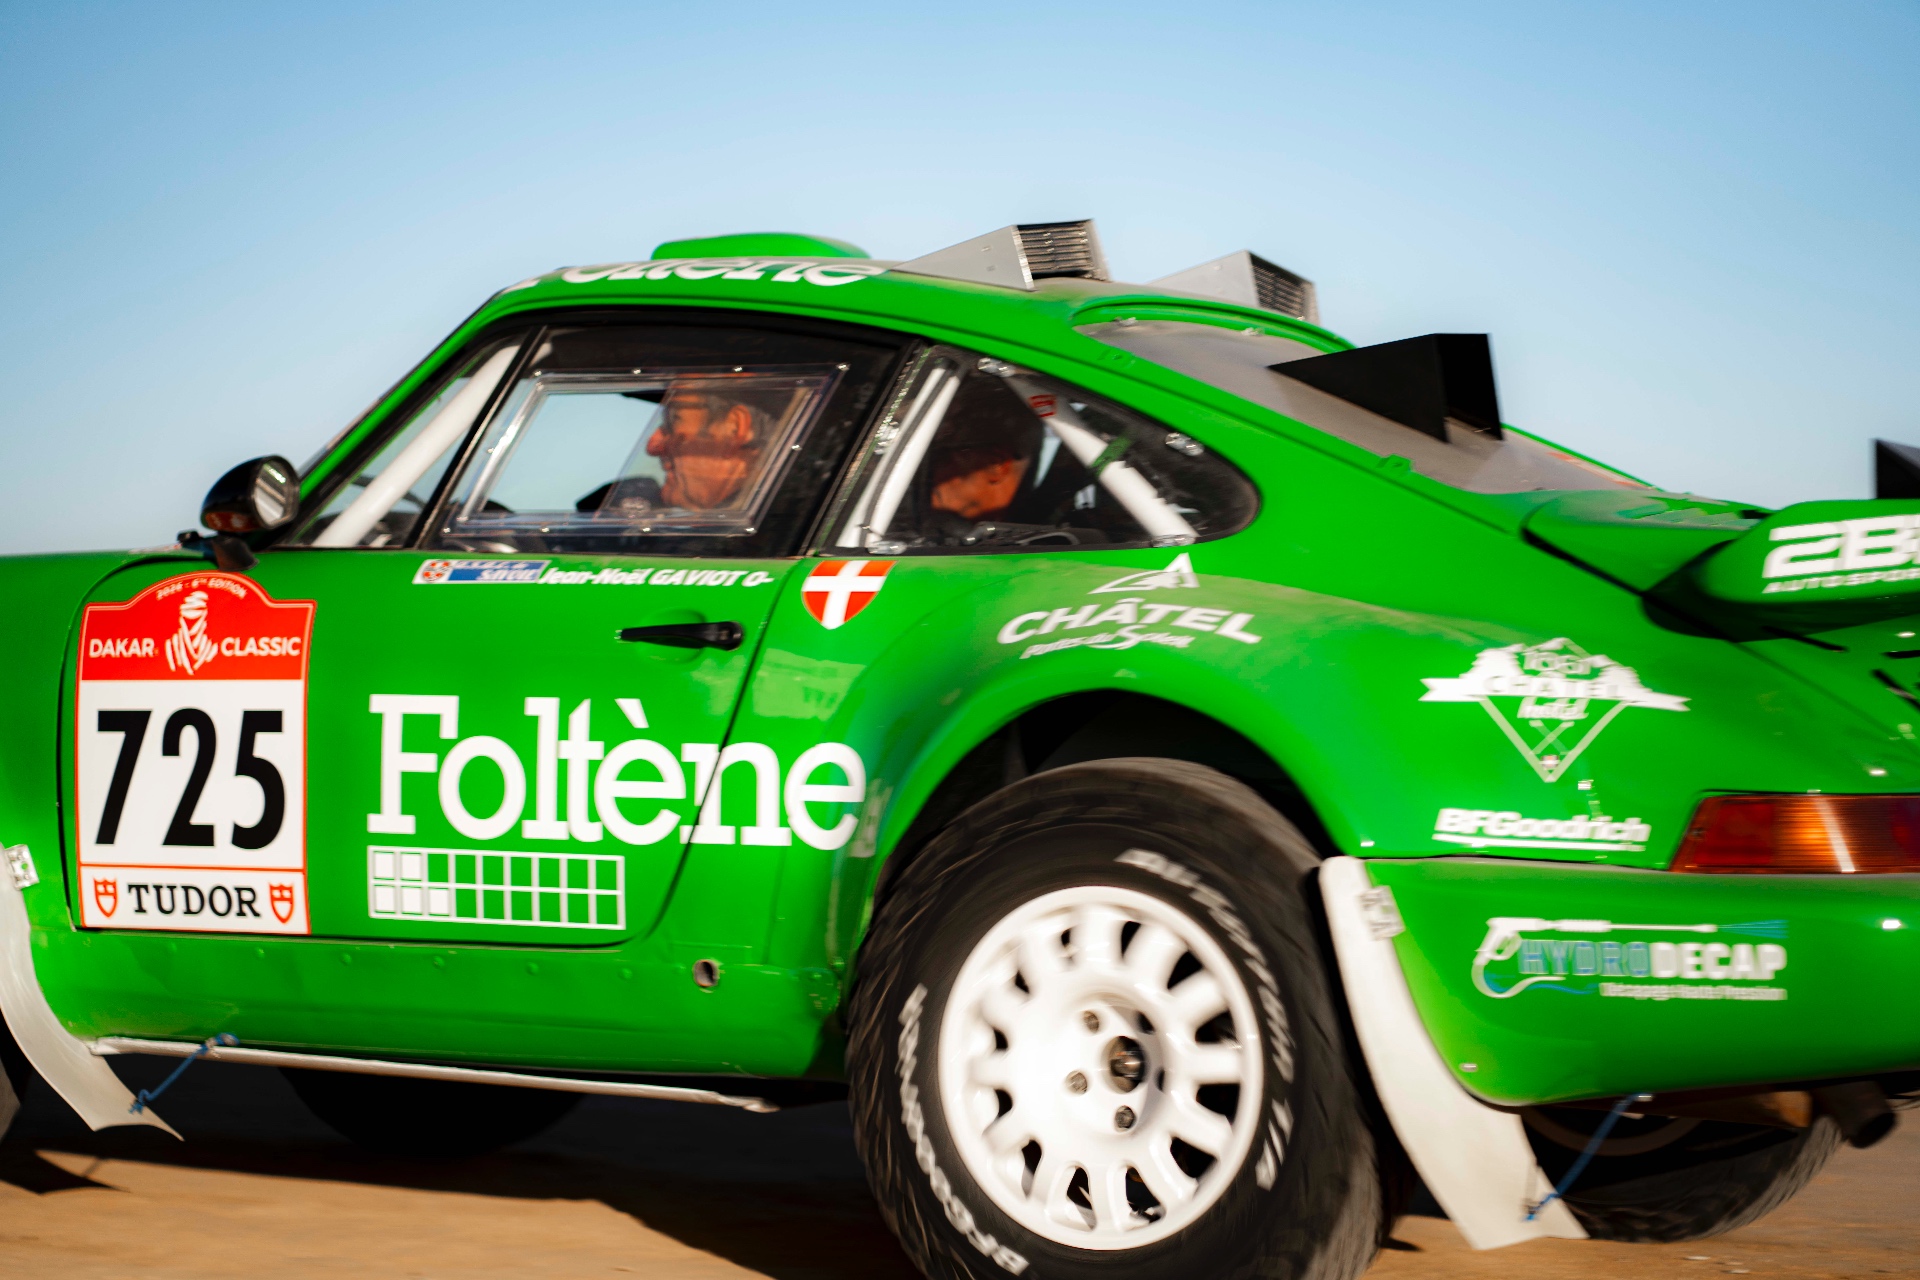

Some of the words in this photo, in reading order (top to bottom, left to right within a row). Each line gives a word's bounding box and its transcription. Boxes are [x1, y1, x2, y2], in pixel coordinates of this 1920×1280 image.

[1762, 513, 1920, 579] 2B
[208, 577, 247, 600] EDITION
[537, 567, 654, 585] Jean-Noël
[648, 568, 750, 586] GAVIOT
[997, 597, 1262, 644] CHÂTEL
[89, 637, 155, 658] DAKAR
[220, 636, 302, 657] CLASSIC
[95, 708, 286, 850] 725
[366, 693, 866, 850] Foltène
[1434, 807, 1651, 842] BFGoodrich
[127, 883, 261, 918] TUDOR
